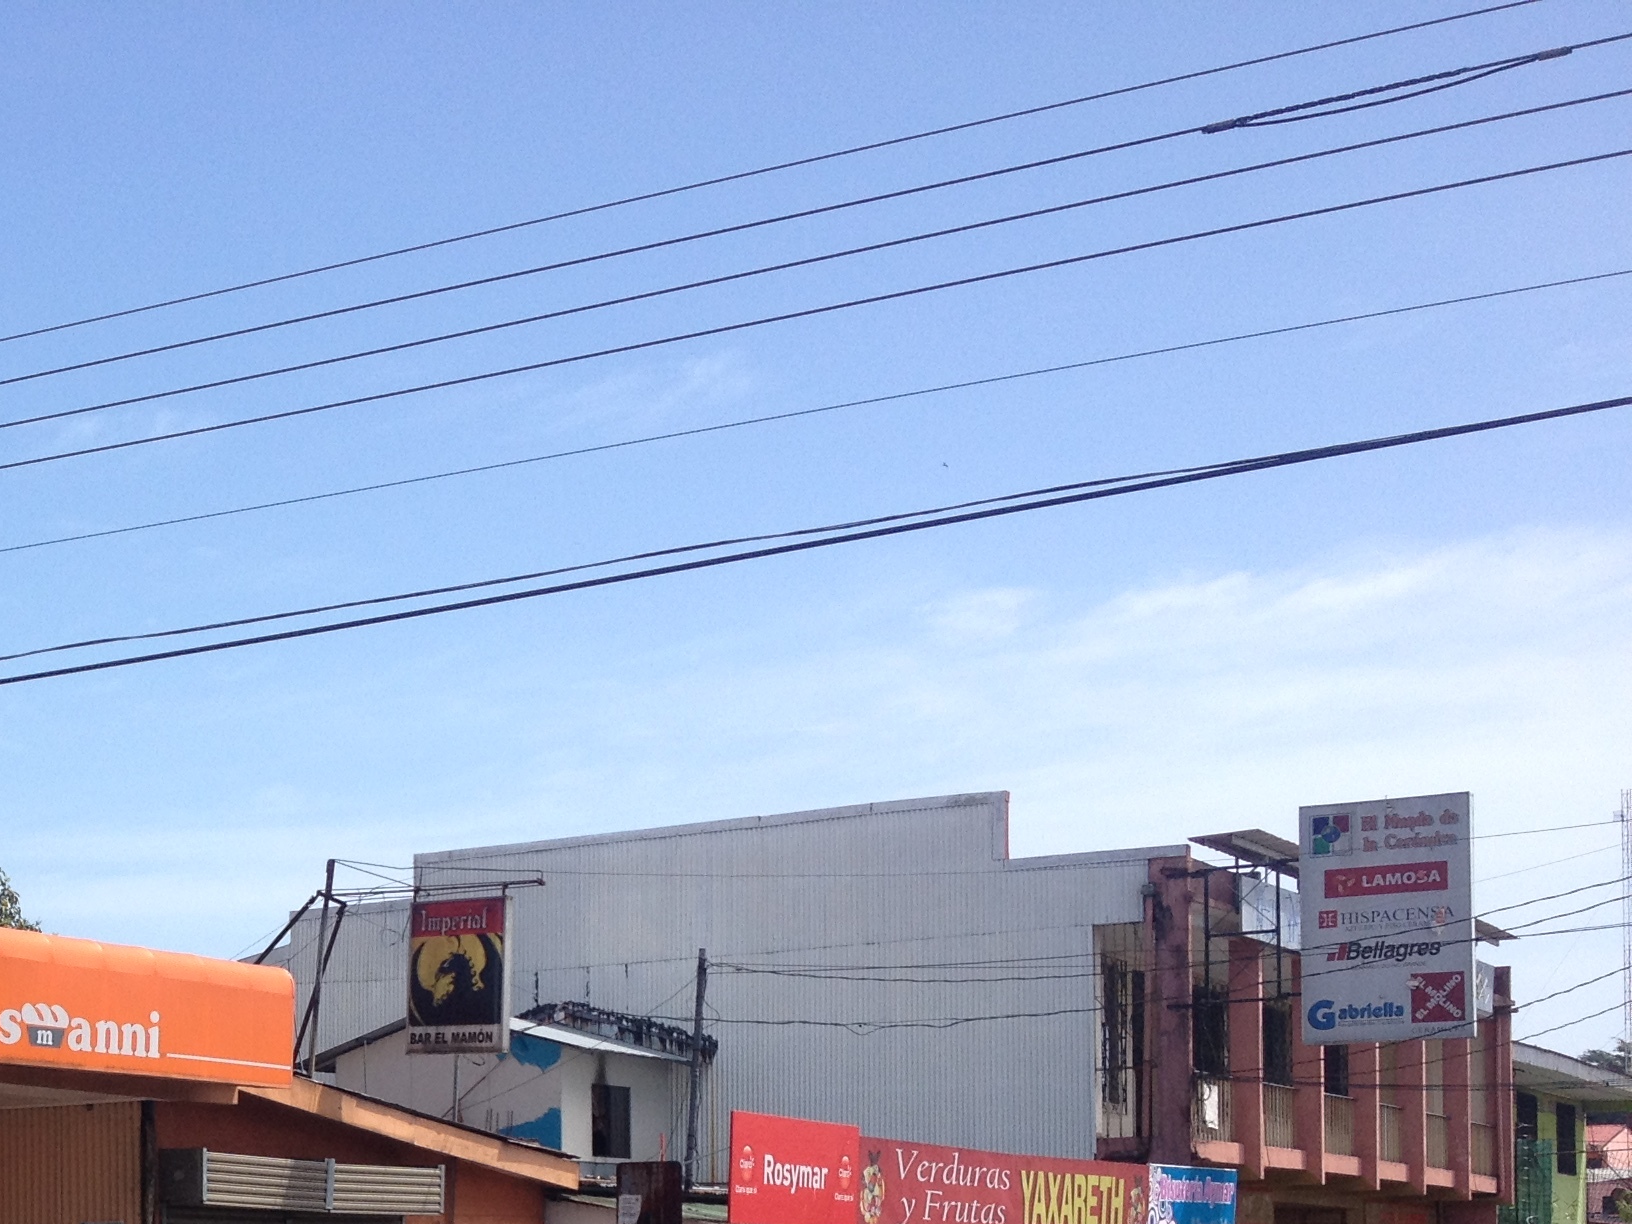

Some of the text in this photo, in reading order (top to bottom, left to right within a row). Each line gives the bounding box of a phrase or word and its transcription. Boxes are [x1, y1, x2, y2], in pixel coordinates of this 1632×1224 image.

[1361, 869, 1441, 888] LAMOSA
[420, 907, 489, 935] Imperial
[1346, 940, 1442, 962] Bellagres
[1307, 999, 1405, 1031] Gabriella
[409, 1031, 432, 1045] BAR
[434, 1031, 448, 1045] EL
[763, 1153, 829, 1195] Rosymar
[895, 1148, 1011, 1190] Verduras
